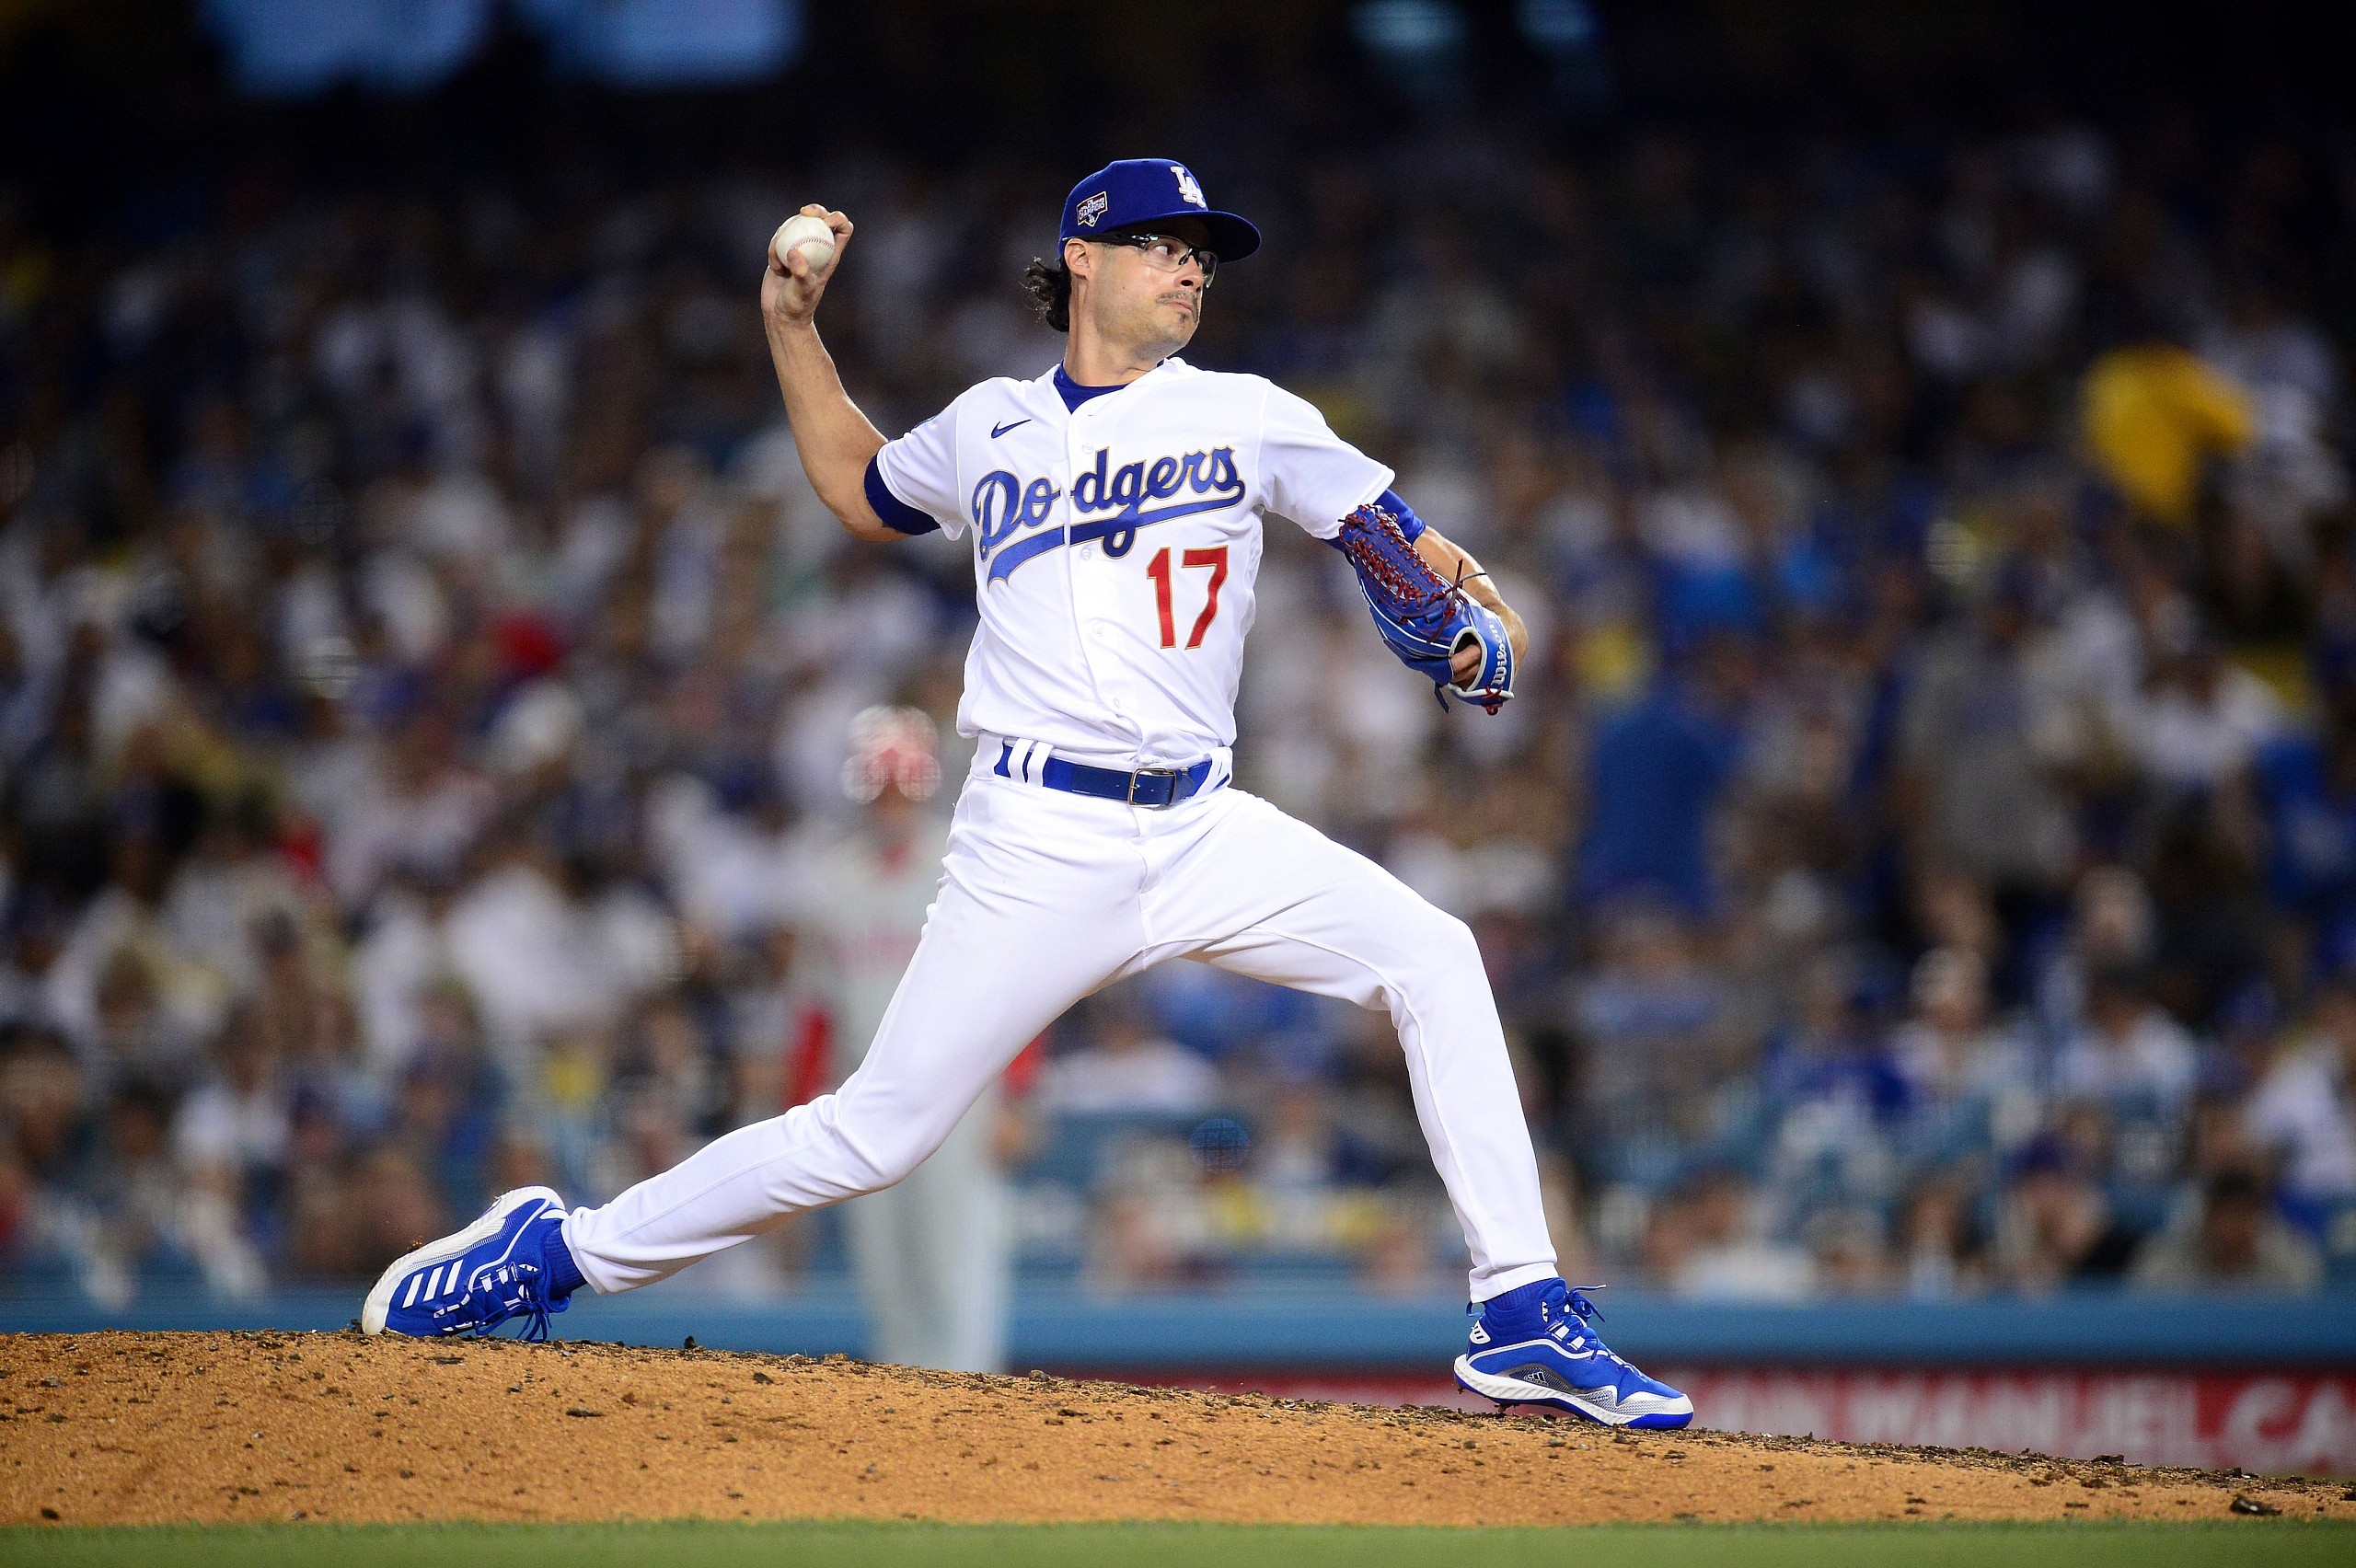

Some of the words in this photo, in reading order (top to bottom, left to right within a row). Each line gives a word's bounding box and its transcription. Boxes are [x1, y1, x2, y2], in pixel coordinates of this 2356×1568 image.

[1170, 166, 1207, 209] LA
[971, 445, 1246, 563] Dodgers
[1145, 544, 1230, 651] 17
[1488, 624, 1508, 686] Wilson
